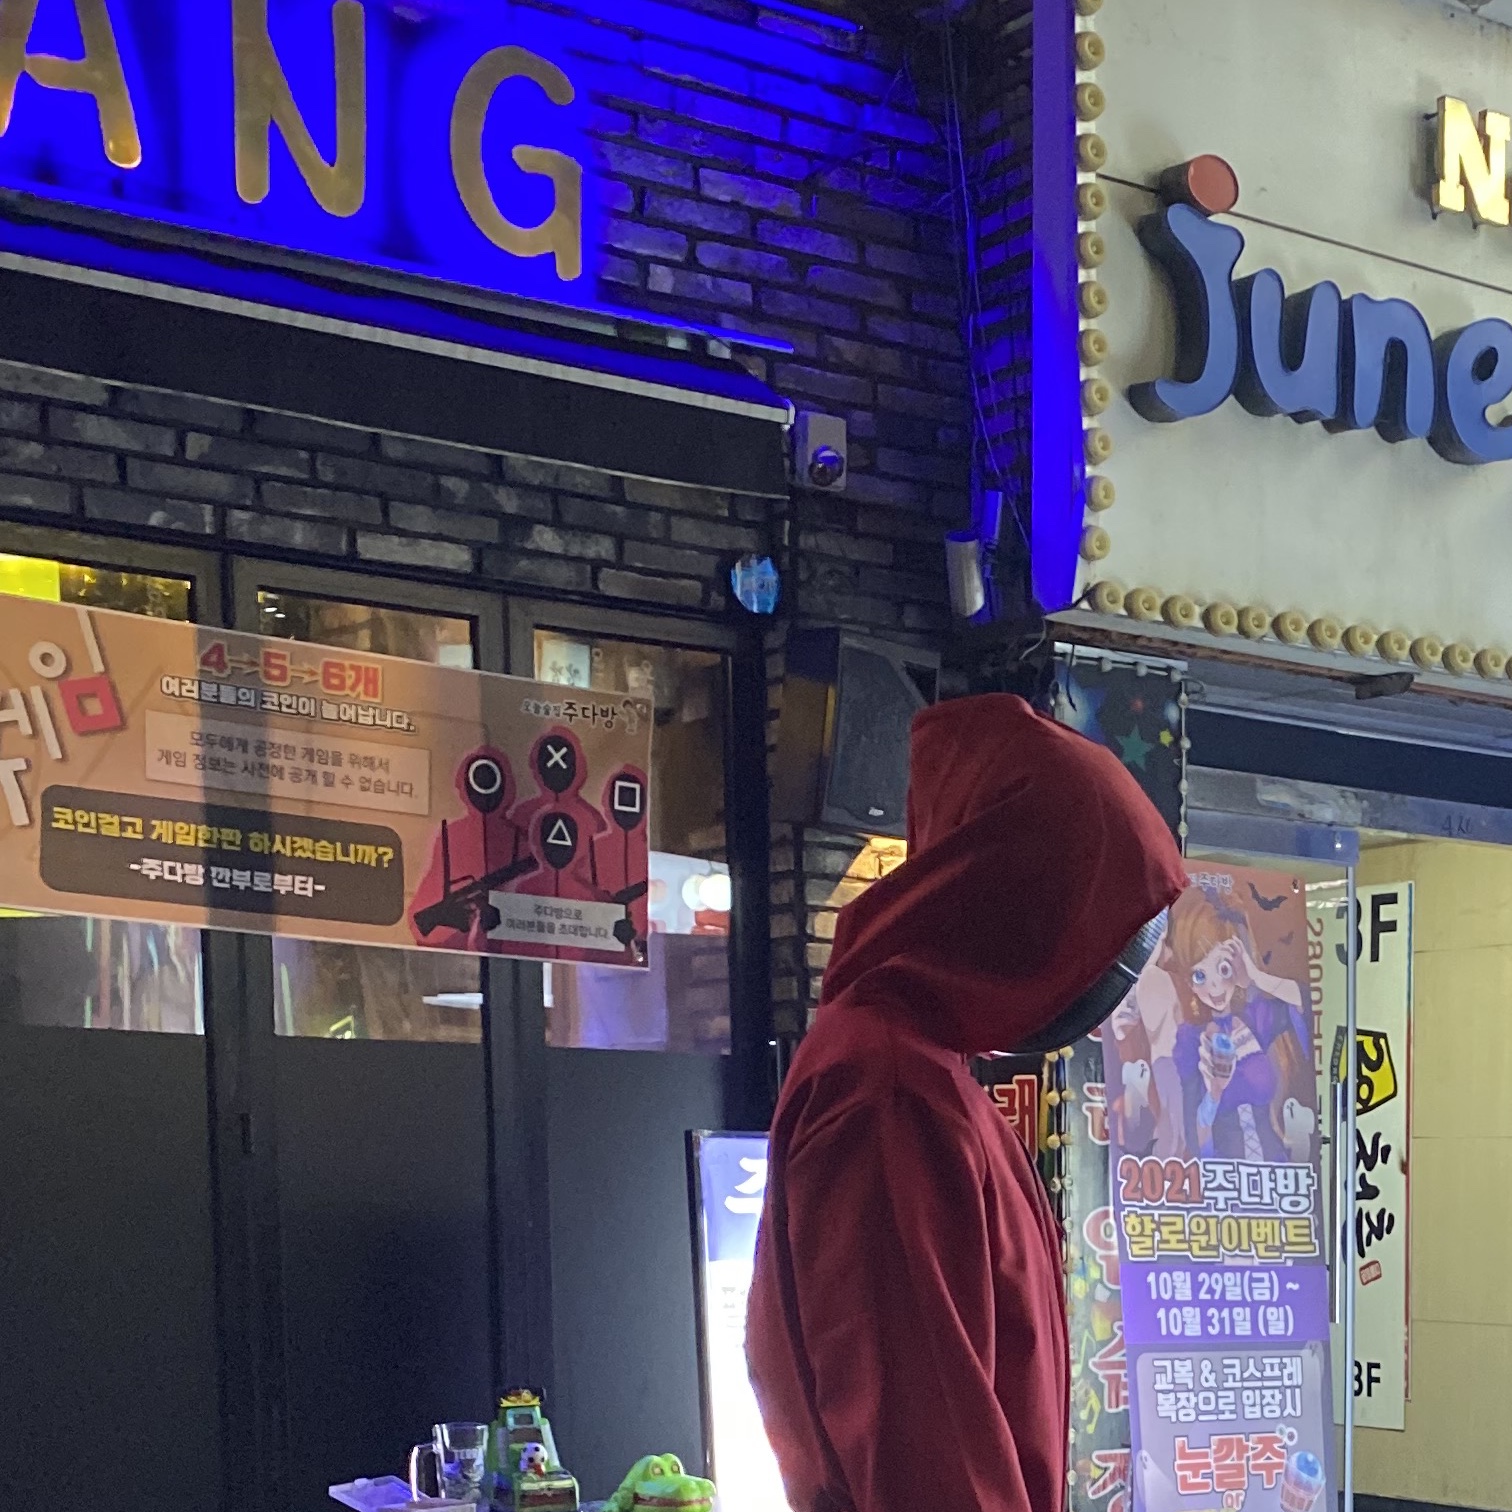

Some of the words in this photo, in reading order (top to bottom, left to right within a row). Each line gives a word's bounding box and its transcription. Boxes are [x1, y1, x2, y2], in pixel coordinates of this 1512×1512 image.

[161, 675, 257, 707] 여러분들의
[261, 688, 316, 718] 코인이
[562, 701, 618, 729] 주다방
[157, 748, 186, 768] 게임
[341, 774, 355, 789] 수
[51, 806, 145, 840] 코인걸고
[151, 818, 242, 853] 게임한판
[248, 831, 394, 869] 하시겠습니까?
[1336, 892, 1399, 966] 3F
[1122, 1210, 1318, 1261] 할로윈이벤트
[1146, 1271, 1192, 1301] 10월
[1198, 1270, 1279, 1302] 29일(금)
[1157, 1306, 1202, 1336] 10월
[1207, 1306, 1252, 1335] 31일
[1258, 1305, 1294, 1337] (일)
[1153, 1358, 1195, 1390] 교복
[1200, 1358, 1218, 1389] &
[1222, 1356, 1303, 1389] 코스프레
[1157, 1390, 1238, 1423] 복장으로
[1242, 1387, 1302, 1420] 입장시
[1174, 1433, 1288, 1495] 눈깔주
